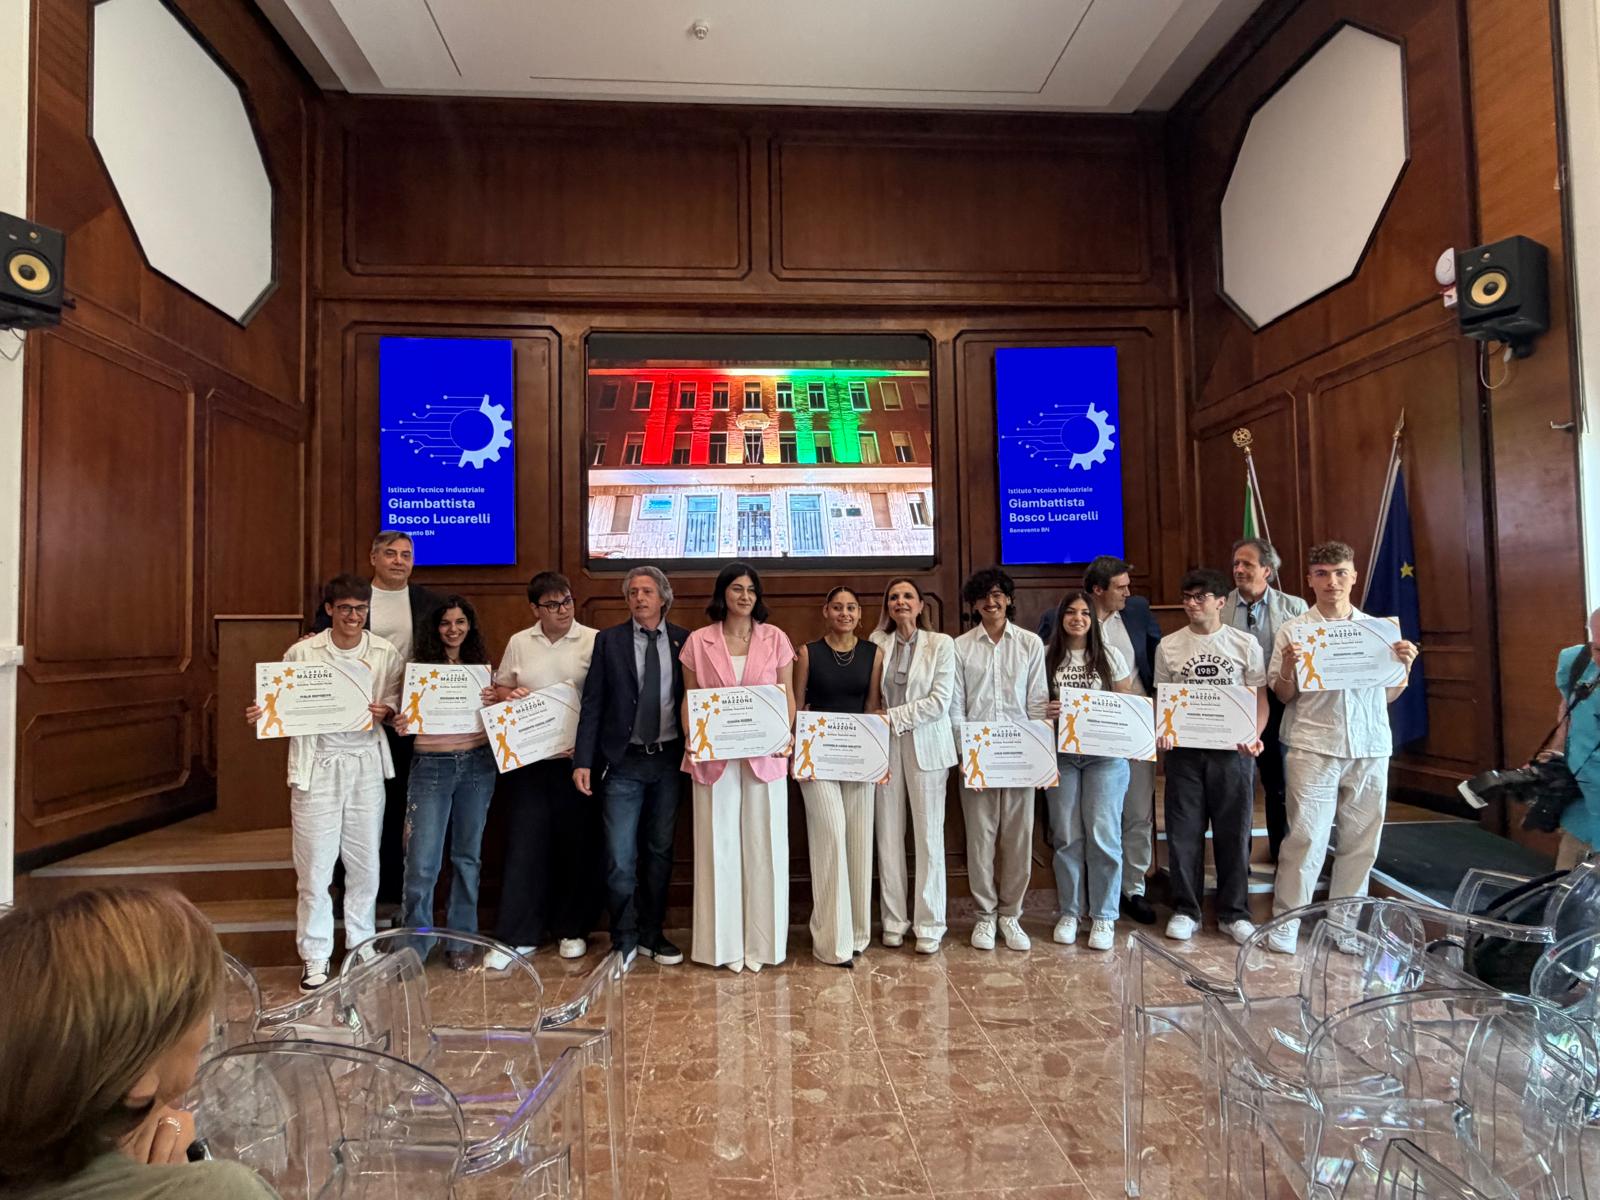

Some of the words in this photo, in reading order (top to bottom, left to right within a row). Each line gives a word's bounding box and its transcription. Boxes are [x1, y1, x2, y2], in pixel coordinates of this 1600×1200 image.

[388, 498, 476, 509] Giambattista
[1008, 497, 1085, 508] Giambattista
[388, 513, 430, 524] Bosco
[433, 513, 491, 524] Lucarelli
[1009, 512, 1045, 522] Bosco
[1048, 511, 1099, 522] Lucarelli
[1181, 654, 1235, 677] HILFIGER
[1197, 667, 1217, 675] 1985
[515, 701, 546, 715] MAZZONE
